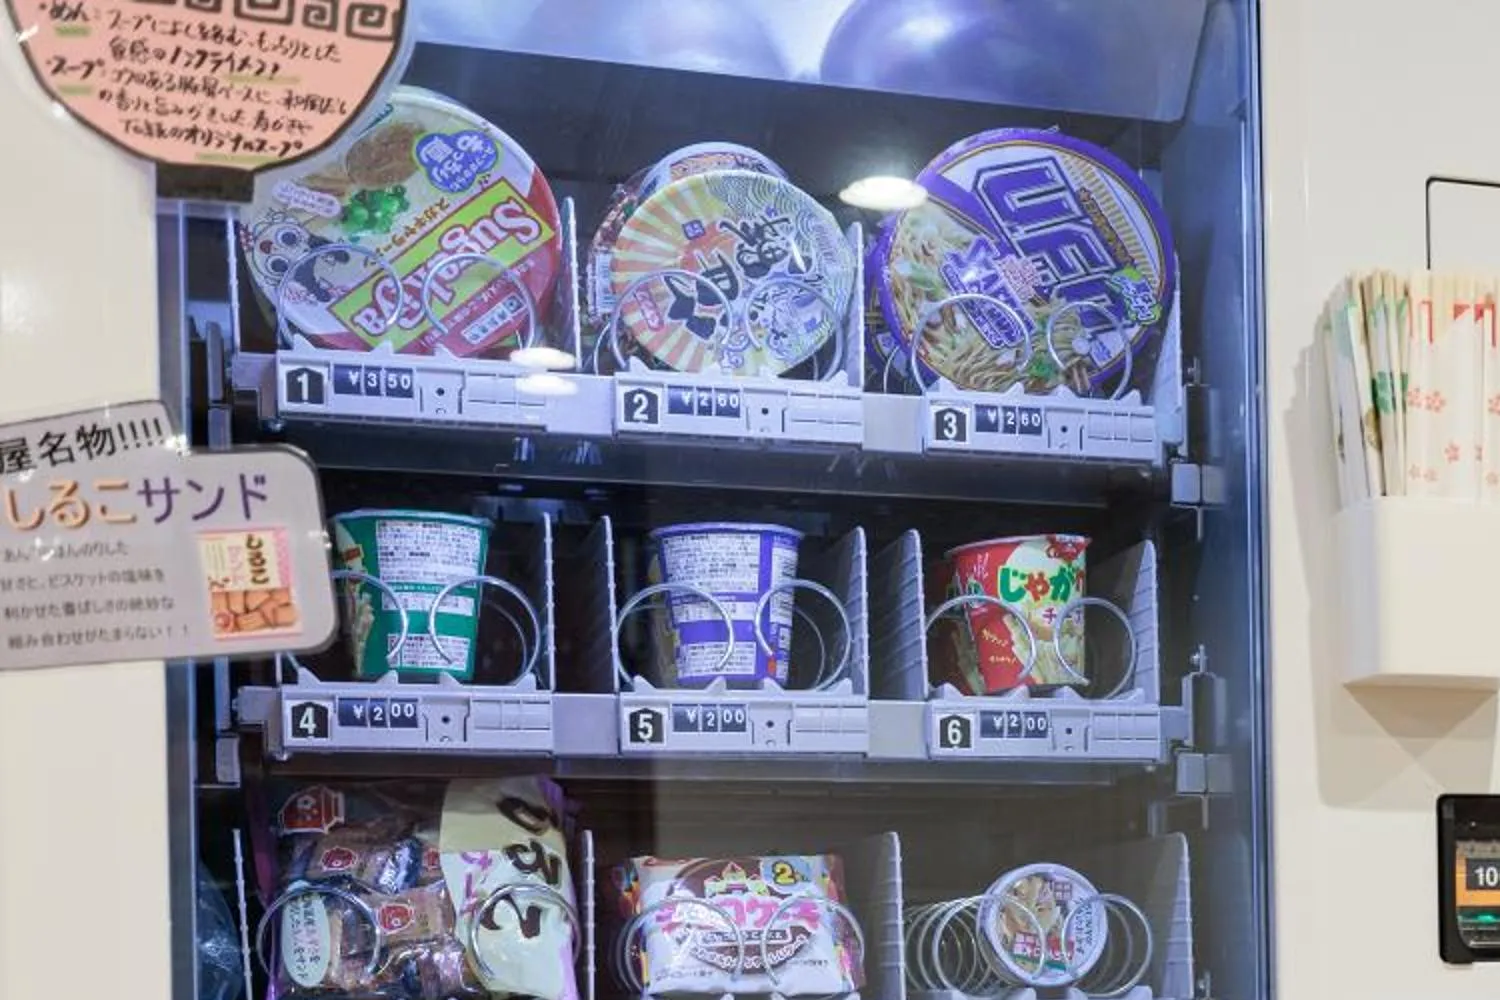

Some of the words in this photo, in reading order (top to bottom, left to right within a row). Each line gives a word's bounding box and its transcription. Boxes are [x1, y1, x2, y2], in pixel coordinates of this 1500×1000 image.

[292, 371, 311, 400] 1
[347, 365, 413, 395] ¥350
[632, 395, 651, 423] 2
[682, 392, 741, 411] ¥260
[943, 411, 960, 440] 3
[987, 411, 1043, 429] ¥260
[5, 474, 267, 532] しるこサンド
[299, 705, 317, 735] 4
[354, 702, 417, 721] ¥200
[686, 707, 746, 728] ¥200
[993, 713, 1048, 731] ¥200
[638, 714, 654, 740] 5
[946, 718, 963, 745] 6
